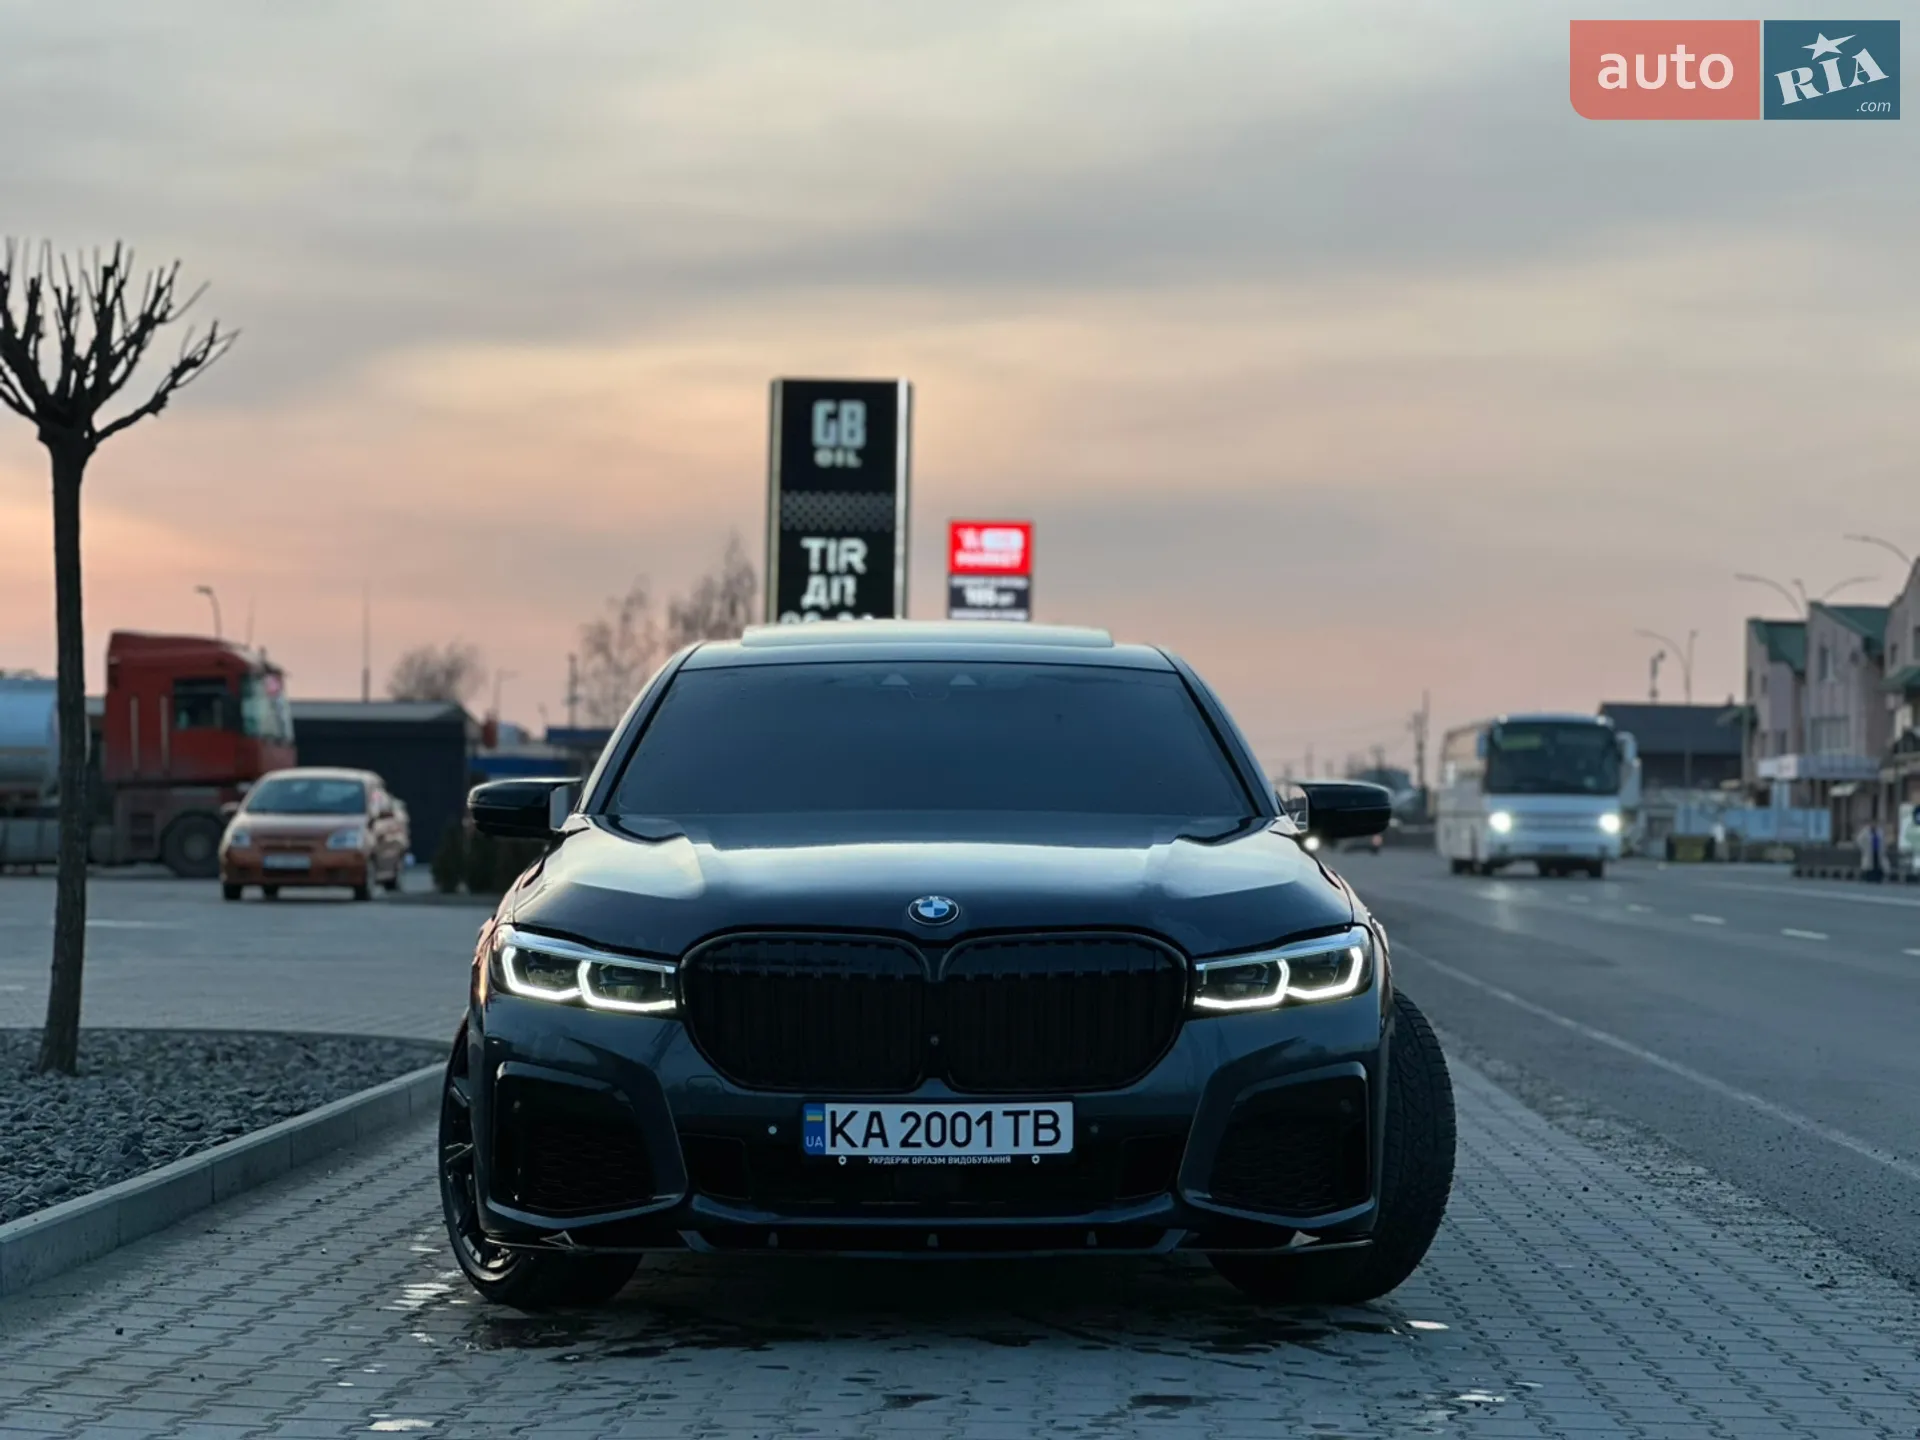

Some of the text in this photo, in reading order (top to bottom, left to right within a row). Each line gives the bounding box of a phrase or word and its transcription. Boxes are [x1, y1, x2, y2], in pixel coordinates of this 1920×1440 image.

[812, 399, 866, 449] GB
[814, 448, 862, 468] OIL
[801, 537, 867, 574] TIR
[801, 574, 857, 611] ДП
[805, 1135, 824, 1148] UA
[829, 1109, 1062, 1149] KA 2001 TB
[911, 1156, 946, 1165] ОРГАЗМ
[948, 1155, 1011, 1165] ВИДОБУВАННЯ
